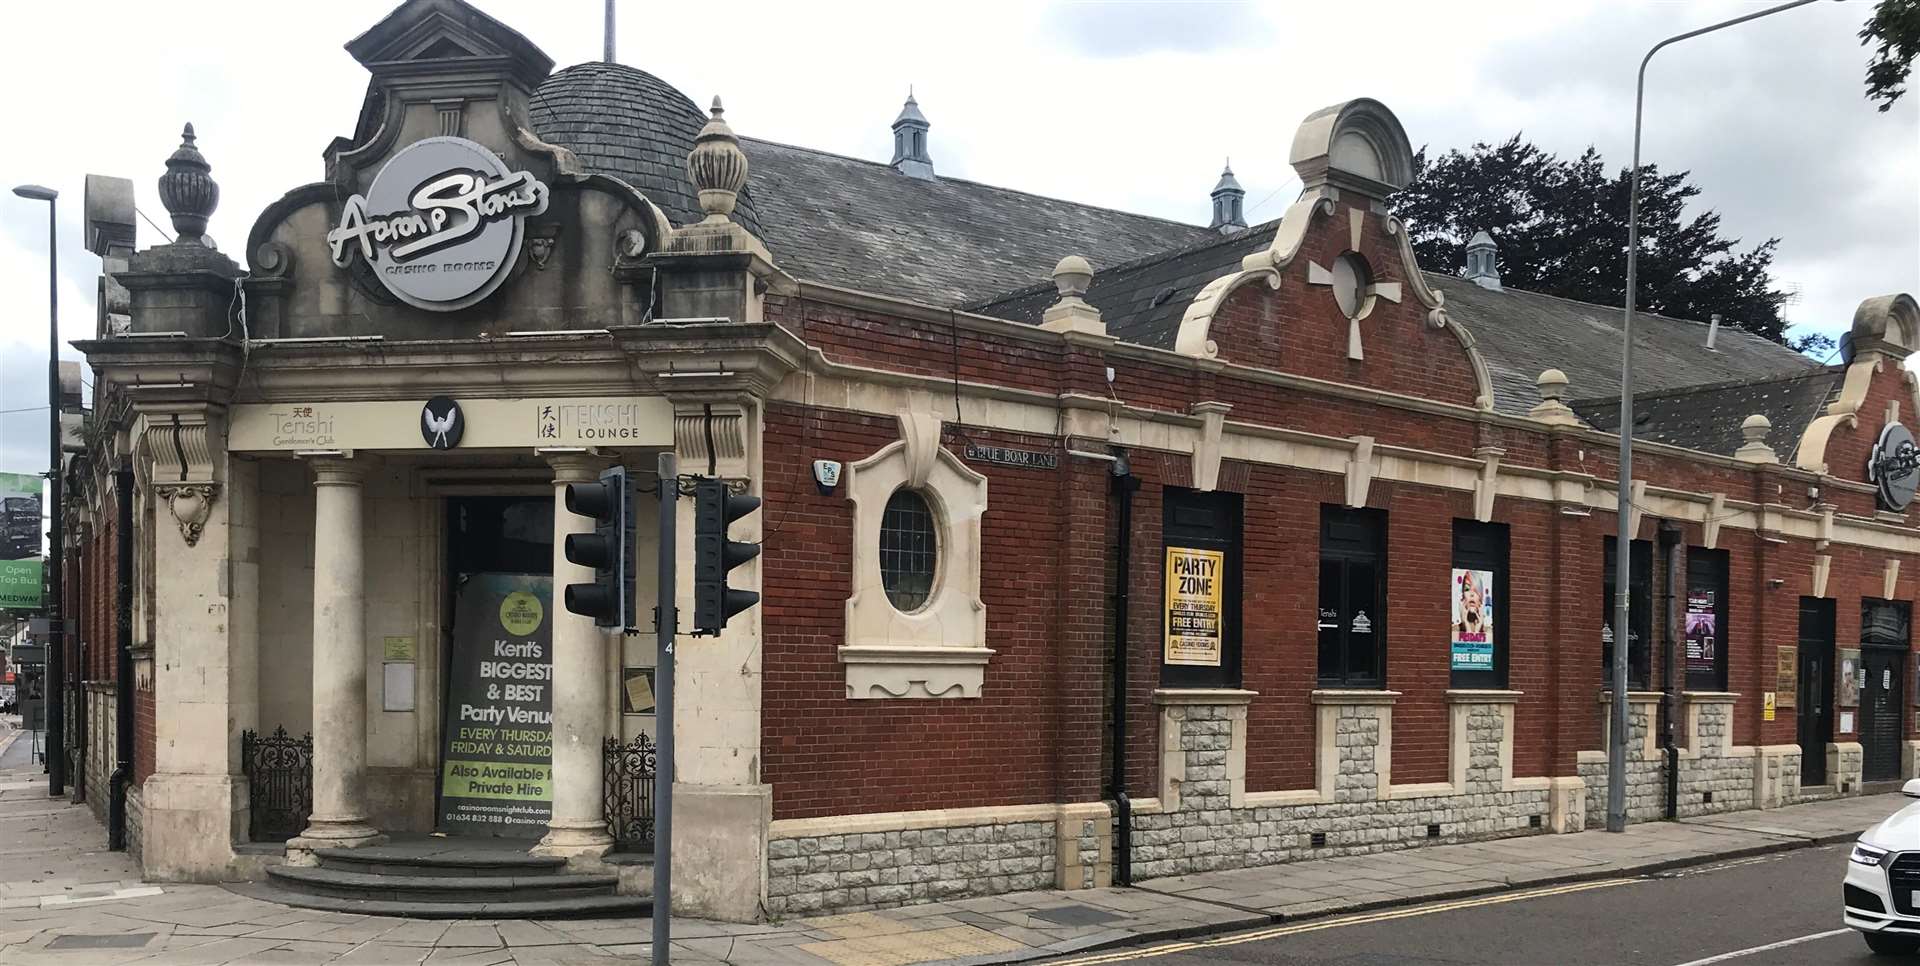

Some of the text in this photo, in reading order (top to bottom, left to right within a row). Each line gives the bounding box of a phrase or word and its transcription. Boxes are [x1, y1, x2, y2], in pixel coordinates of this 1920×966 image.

[328, 194, 427, 260] Aaron
[385, 261, 495, 275] CASINO ROOMS
[293, 407, 312, 418] 天使
[562, 404, 639, 426] TENSHI
[269, 411, 334, 434] Tenshi
[542, 406, 556, 438] 天使
[578, 428, 639, 438] LOUNGE
[1004, 450, 1029, 464] BOAR
[6, 566, 31, 576] Open
[1174, 556, 1216, 577] PARTY
[0, 576, 37, 585] Top Bus
[1178, 576, 1212, 596] ZONE
[1173, 602, 1216, 611] EVERY THURSDAY
[1172, 616, 1216, 629] FREE ENTRY
[665, 642, 673, 654] 4
[1453, 653, 1471, 662] FREE
[480, 662, 553, 680] BIGGEST
[487, 683, 544, 702] & BEST
[461, 704, 505, 725] Party
[460, 728, 552, 742] EVERY THURSDA
[451, 742, 493, 754] FRIDAY
[495, 744, 504, 755] &
[450, 765, 479, 777] Also
[482, 767, 544, 780] Available
[469, 781, 543, 796] Private Hire
[457, 804, 551, 815] casinoroomsnightclub.com
[446, 813, 470, 821] 01634
[513, 817, 535, 825] casino
